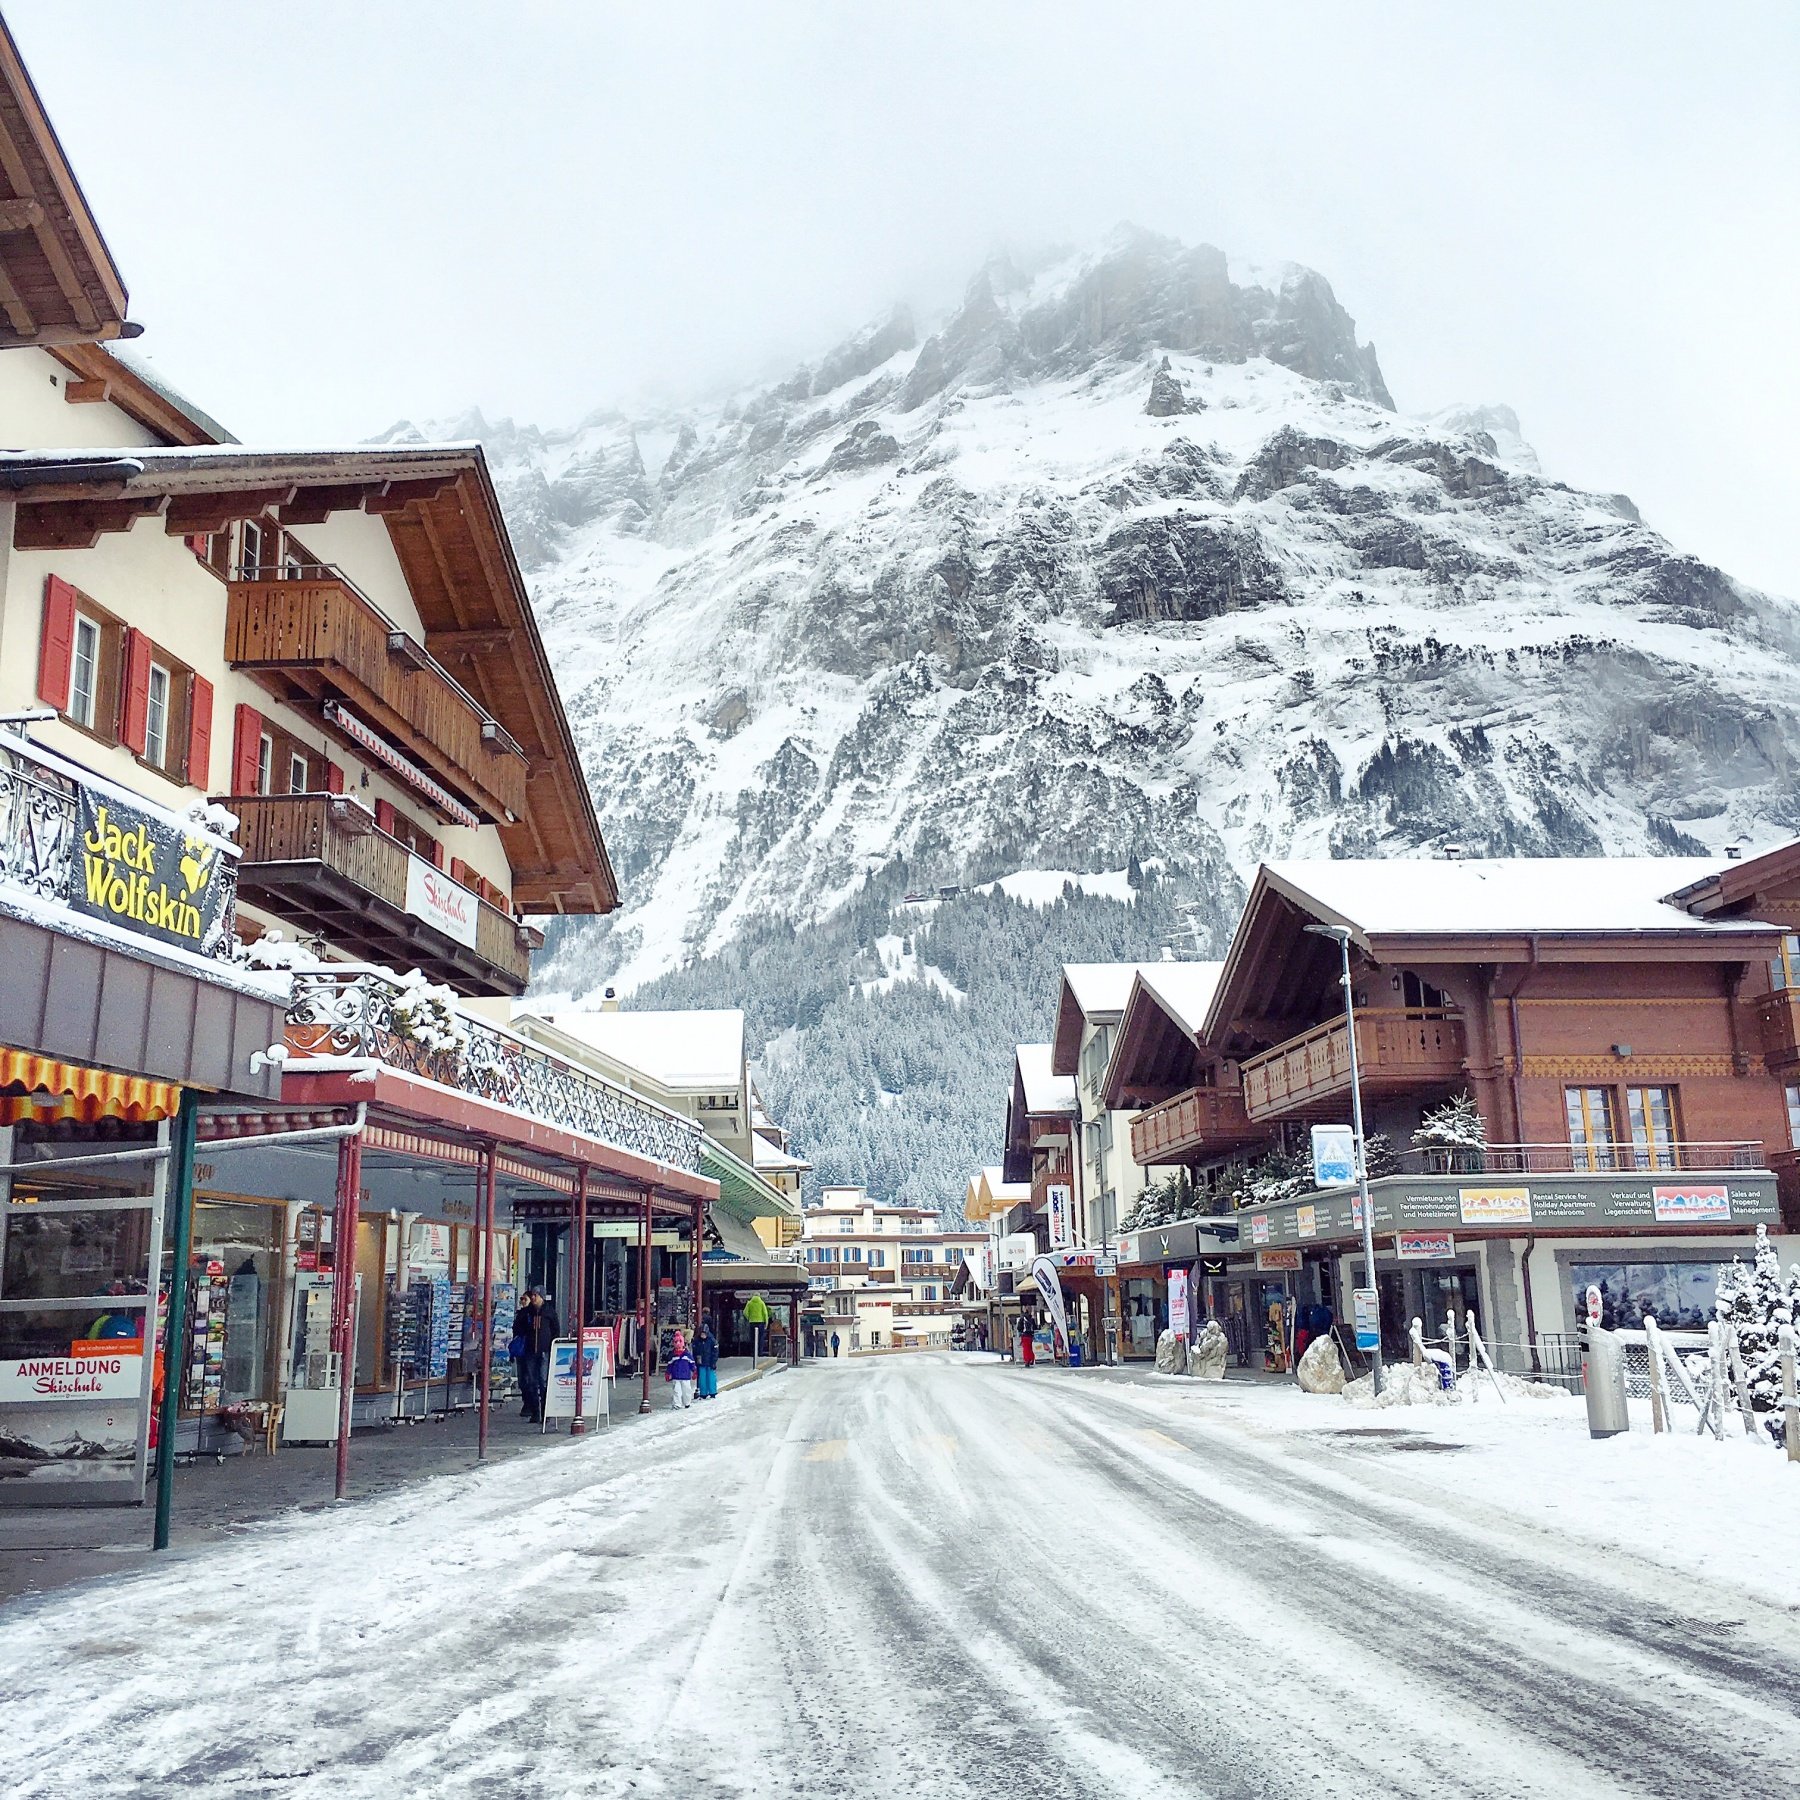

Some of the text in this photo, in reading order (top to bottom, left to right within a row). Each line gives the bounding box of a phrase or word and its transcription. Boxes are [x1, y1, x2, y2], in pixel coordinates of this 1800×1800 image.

[84, 806, 156, 875] Jack
[83, 851, 201, 939] Wolfskin
[423, 872, 467, 924] Skischule
[1405, 1195, 1443, 1203] Vermietung
[1577, 1192, 1587, 1200] for
[1400, 1203, 1457, 1211] Ferienwohnungen
[1533, 1201, 1596, 1209] Holiday Apartments
[1614, 1200, 1651, 1208] Verwaltung
[1732, 1199, 1760, 1207] Property
[1052, 1190, 1060, 1236] INTERSPORT
[1417, 1210, 1458, 1218] Hotelzimmer
[1548, 1208, 1585, 1216] Hotelrooms
[1733, 1207, 1776, 1215] Management
[583, 1331, 608, 1340] SALE
[16, 1359, 121, 1377] ANMELDUNG
[31, 1376, 104, 1394] Skischule
